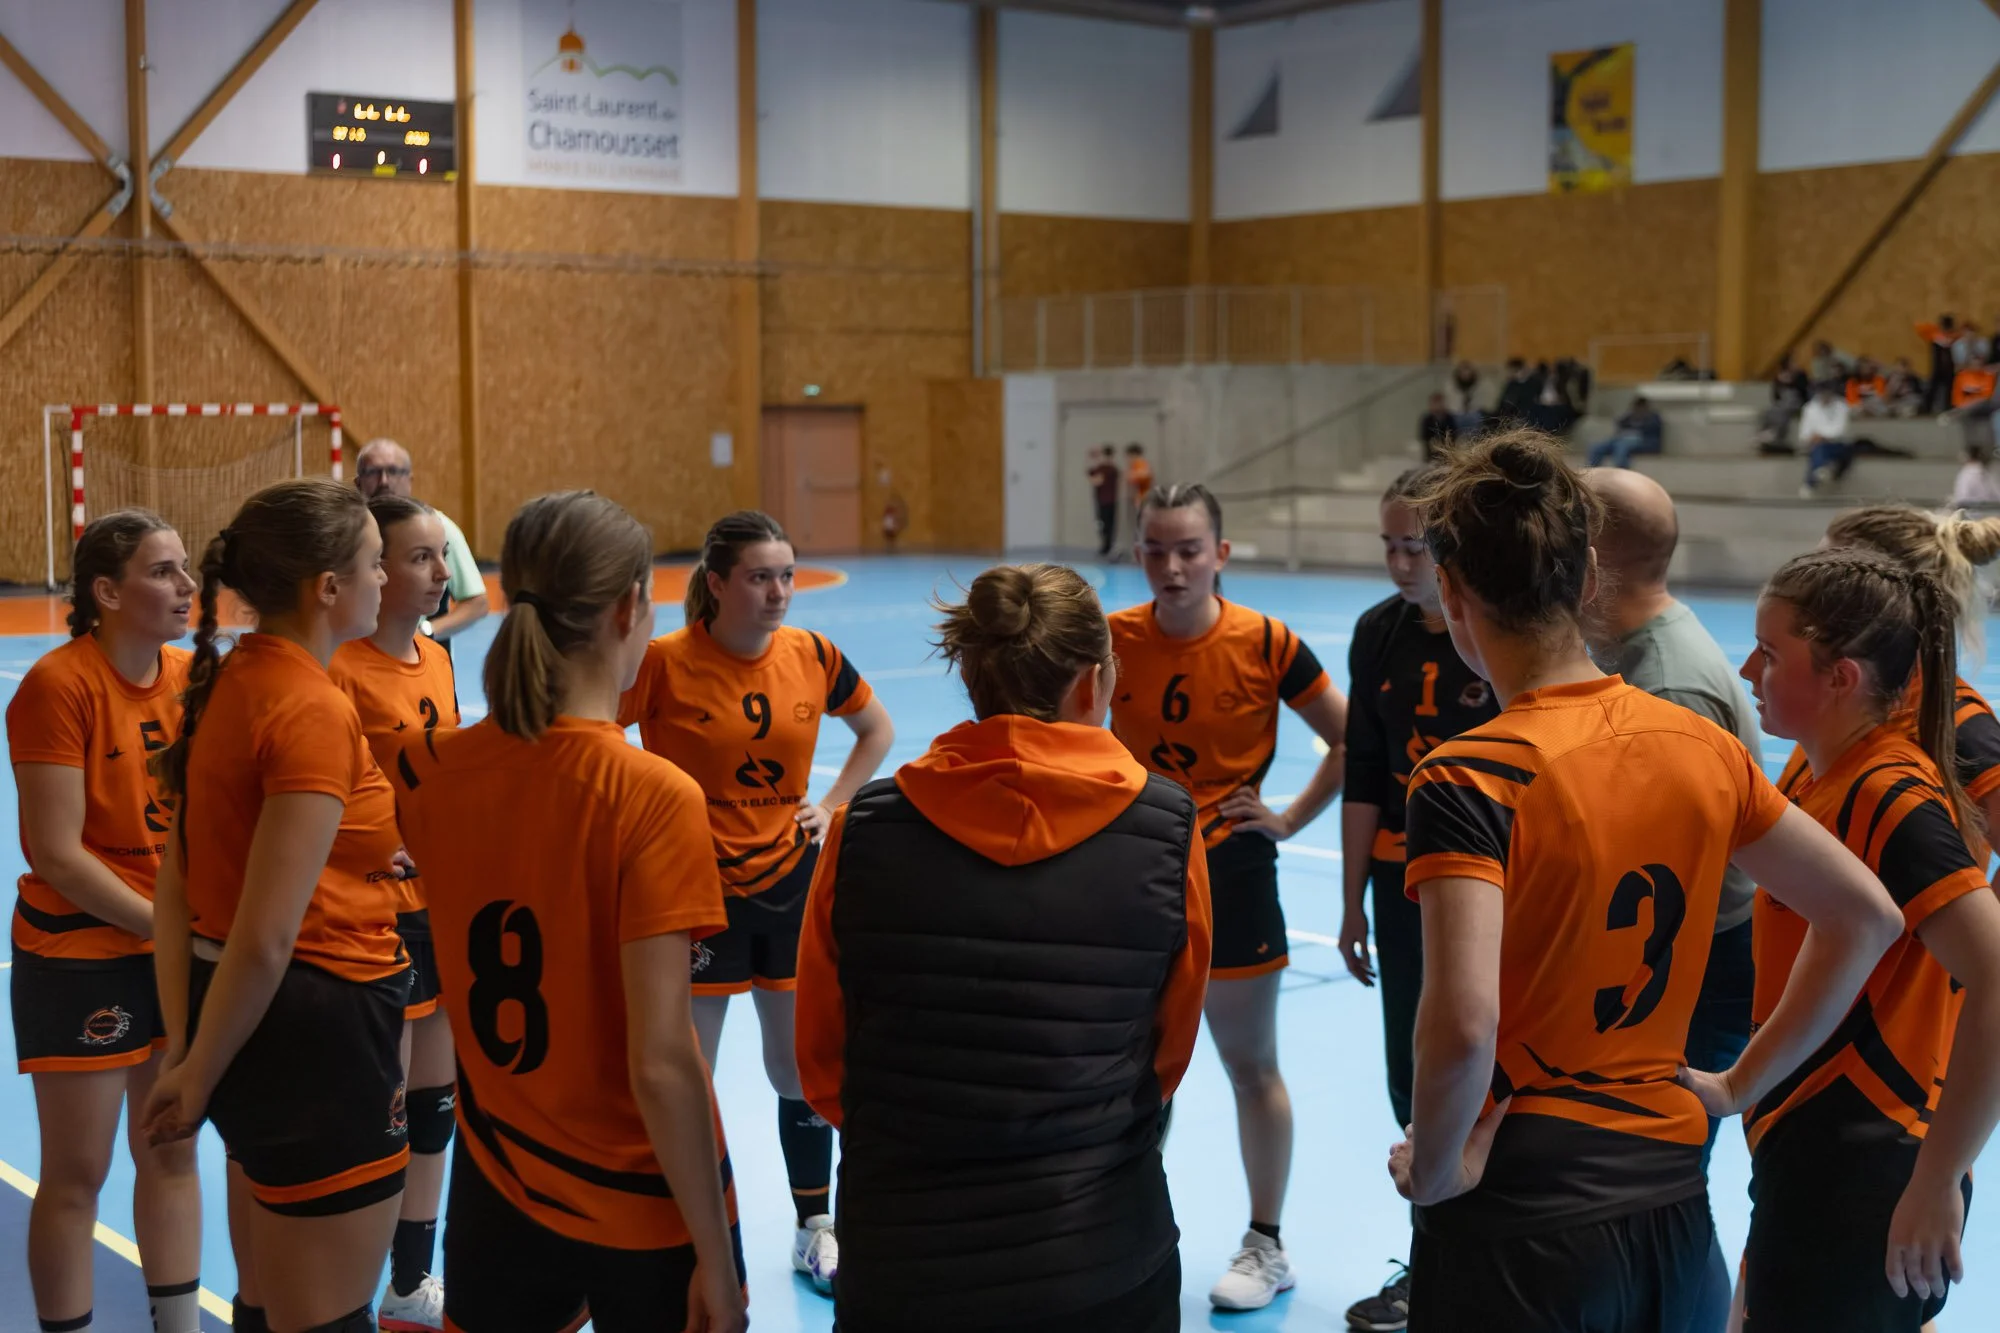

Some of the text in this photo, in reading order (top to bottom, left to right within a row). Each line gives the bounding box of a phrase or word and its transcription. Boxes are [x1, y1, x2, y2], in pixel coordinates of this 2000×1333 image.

[528, 120, 679, 159] Chamousset
[1162, 674, 1189, 723] 6
[1415, 661, 1439, 716] 1
[742, 691, 772, 740] 9
[1594, 863, 1687, 1034] 3
[468, 899, 549, 1075] 8
